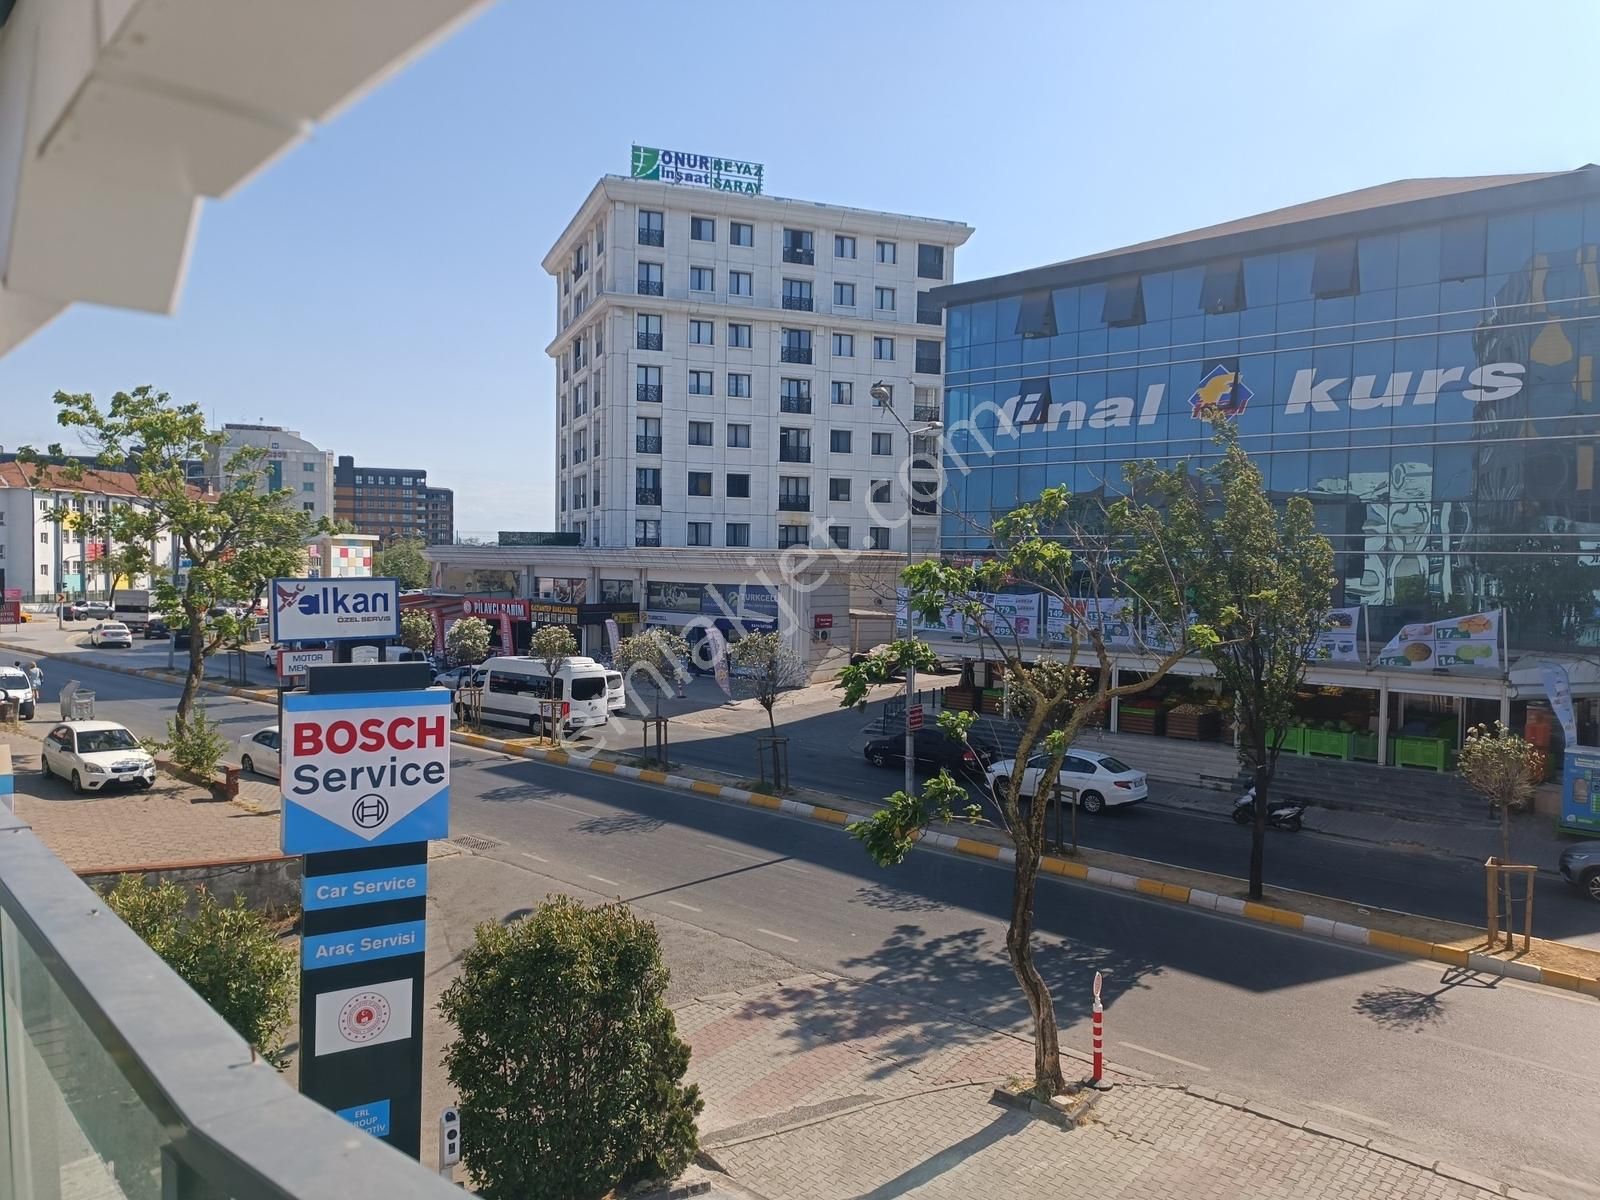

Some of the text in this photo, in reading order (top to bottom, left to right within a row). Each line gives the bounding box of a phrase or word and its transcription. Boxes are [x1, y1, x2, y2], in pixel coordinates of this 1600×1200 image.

[661, 150, 763, 177] ONUR BEYAZ
[713, 176, 762, 195] SARAY
[996, 383, 1165, 436] final
[1284, 362, 1528, 414] kurs
[297, 587, 389, 616] alkan
[337, 615, 360, 623] ÖZEL
[1437, 629, 1453, 639] 17
[292, 654, 324, 662] MOTOR
[1439, 656, 1456, 666] 14
[293, 715, 445, 757] BOSCH
[292, 756, 445, 795] Service
[316, 876, 417, 900] Car Service
[315, 931, 416, 959] Araç Servisi
[352, 1116, 378, 1128] ROUP
[354, 1109, 371, 1118] ERL
[362, 1123, 386, 1135] OTİV
